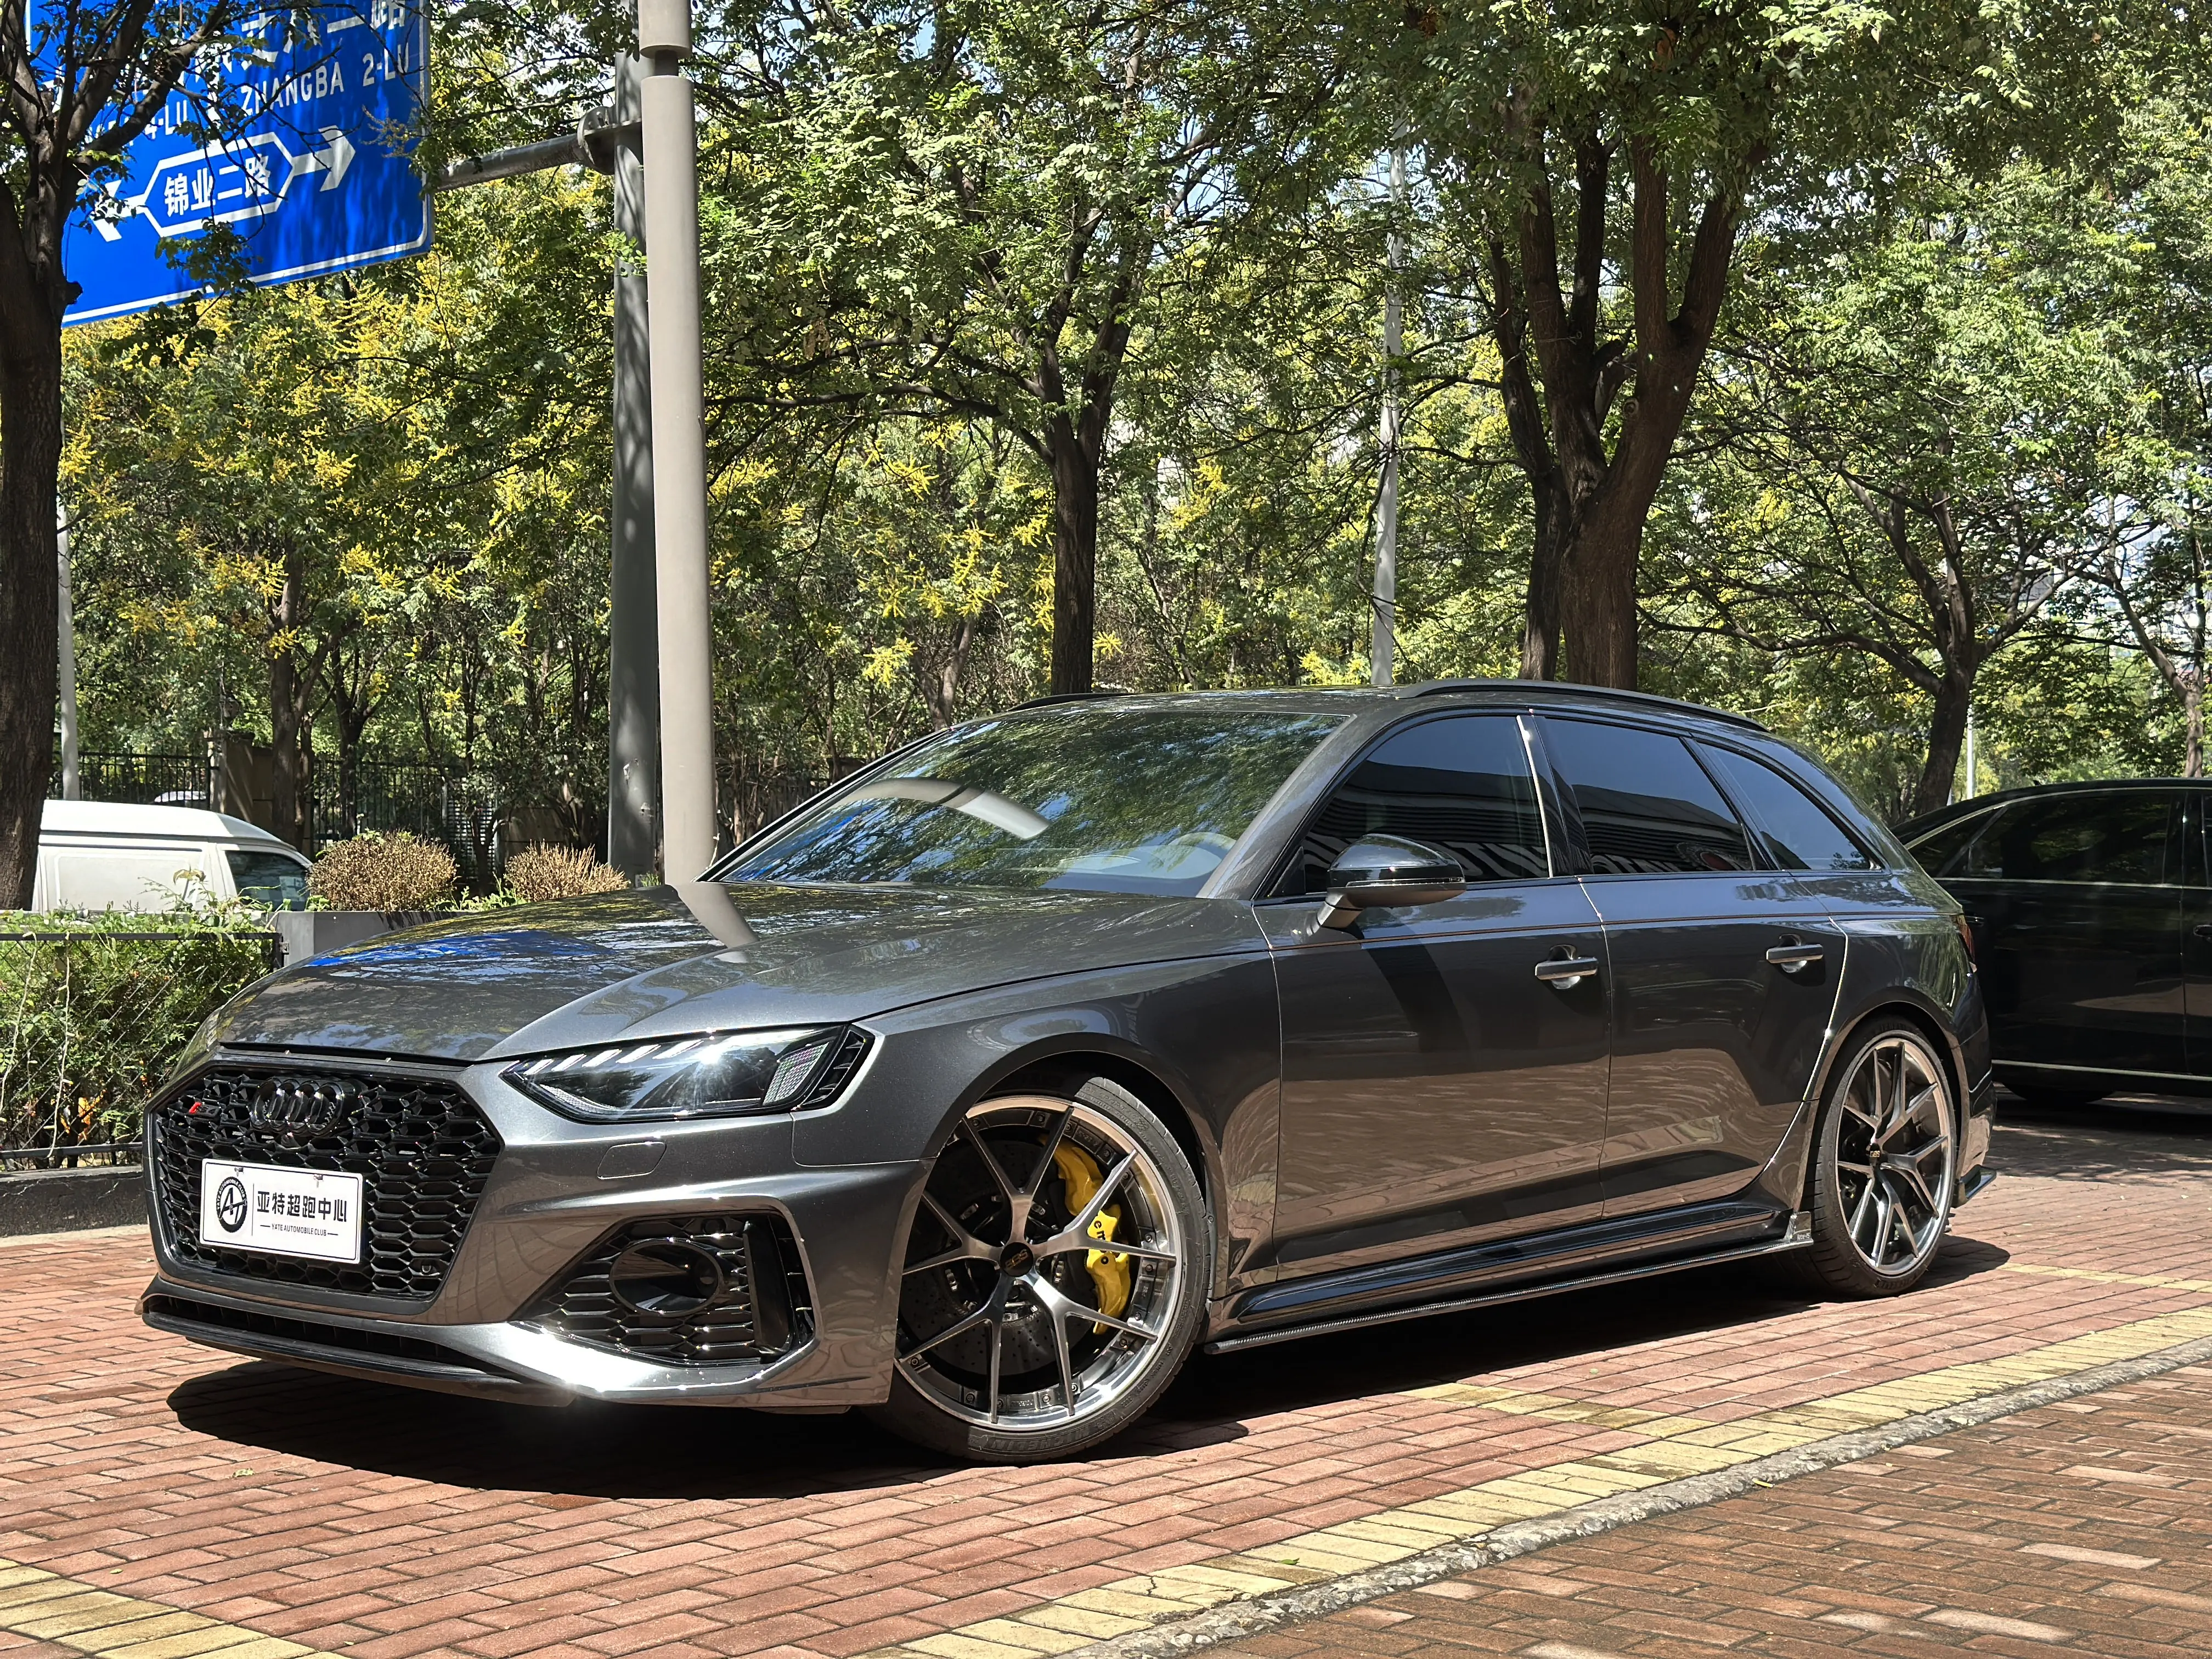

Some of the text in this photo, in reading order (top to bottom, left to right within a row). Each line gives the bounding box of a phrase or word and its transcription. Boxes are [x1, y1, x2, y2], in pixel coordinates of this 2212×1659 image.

[241, 61, 345, 116] ZHANGBA
[362, 42, 409, 87] 2-LU
[164, 153, 271, 218] 锦业二路
[257, 1190, 347, 1222] 亚特超跑中心
[284, 1225, 314, 1234] AUTOMOBILE
[1005, 1249, 1028, 1269] BBS
